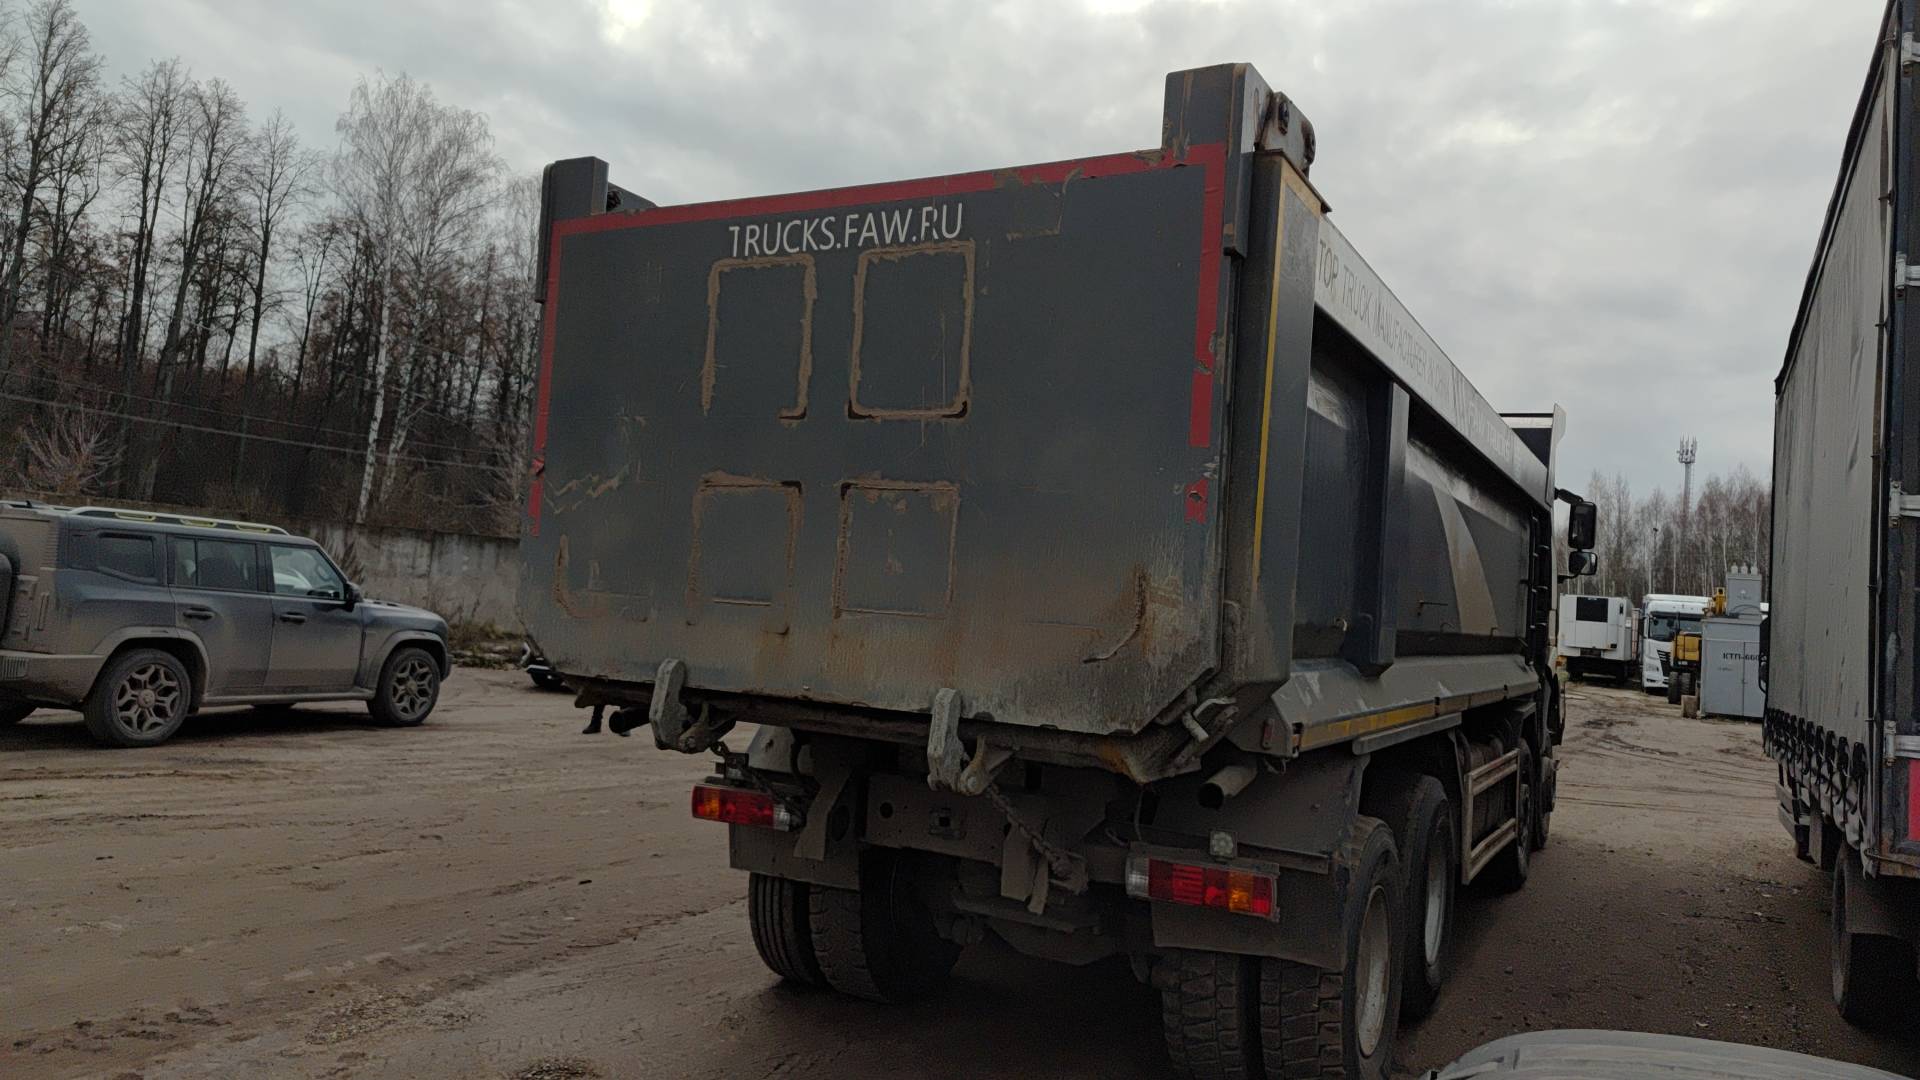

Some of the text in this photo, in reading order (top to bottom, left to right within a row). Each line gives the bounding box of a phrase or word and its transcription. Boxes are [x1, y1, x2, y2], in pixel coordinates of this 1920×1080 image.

[729, 203, 962, 257] TRUCKS.FAW.RU
[1318, 239, 1339, 293] TOP
[1342, 264, 1373, 328] TRUCK
